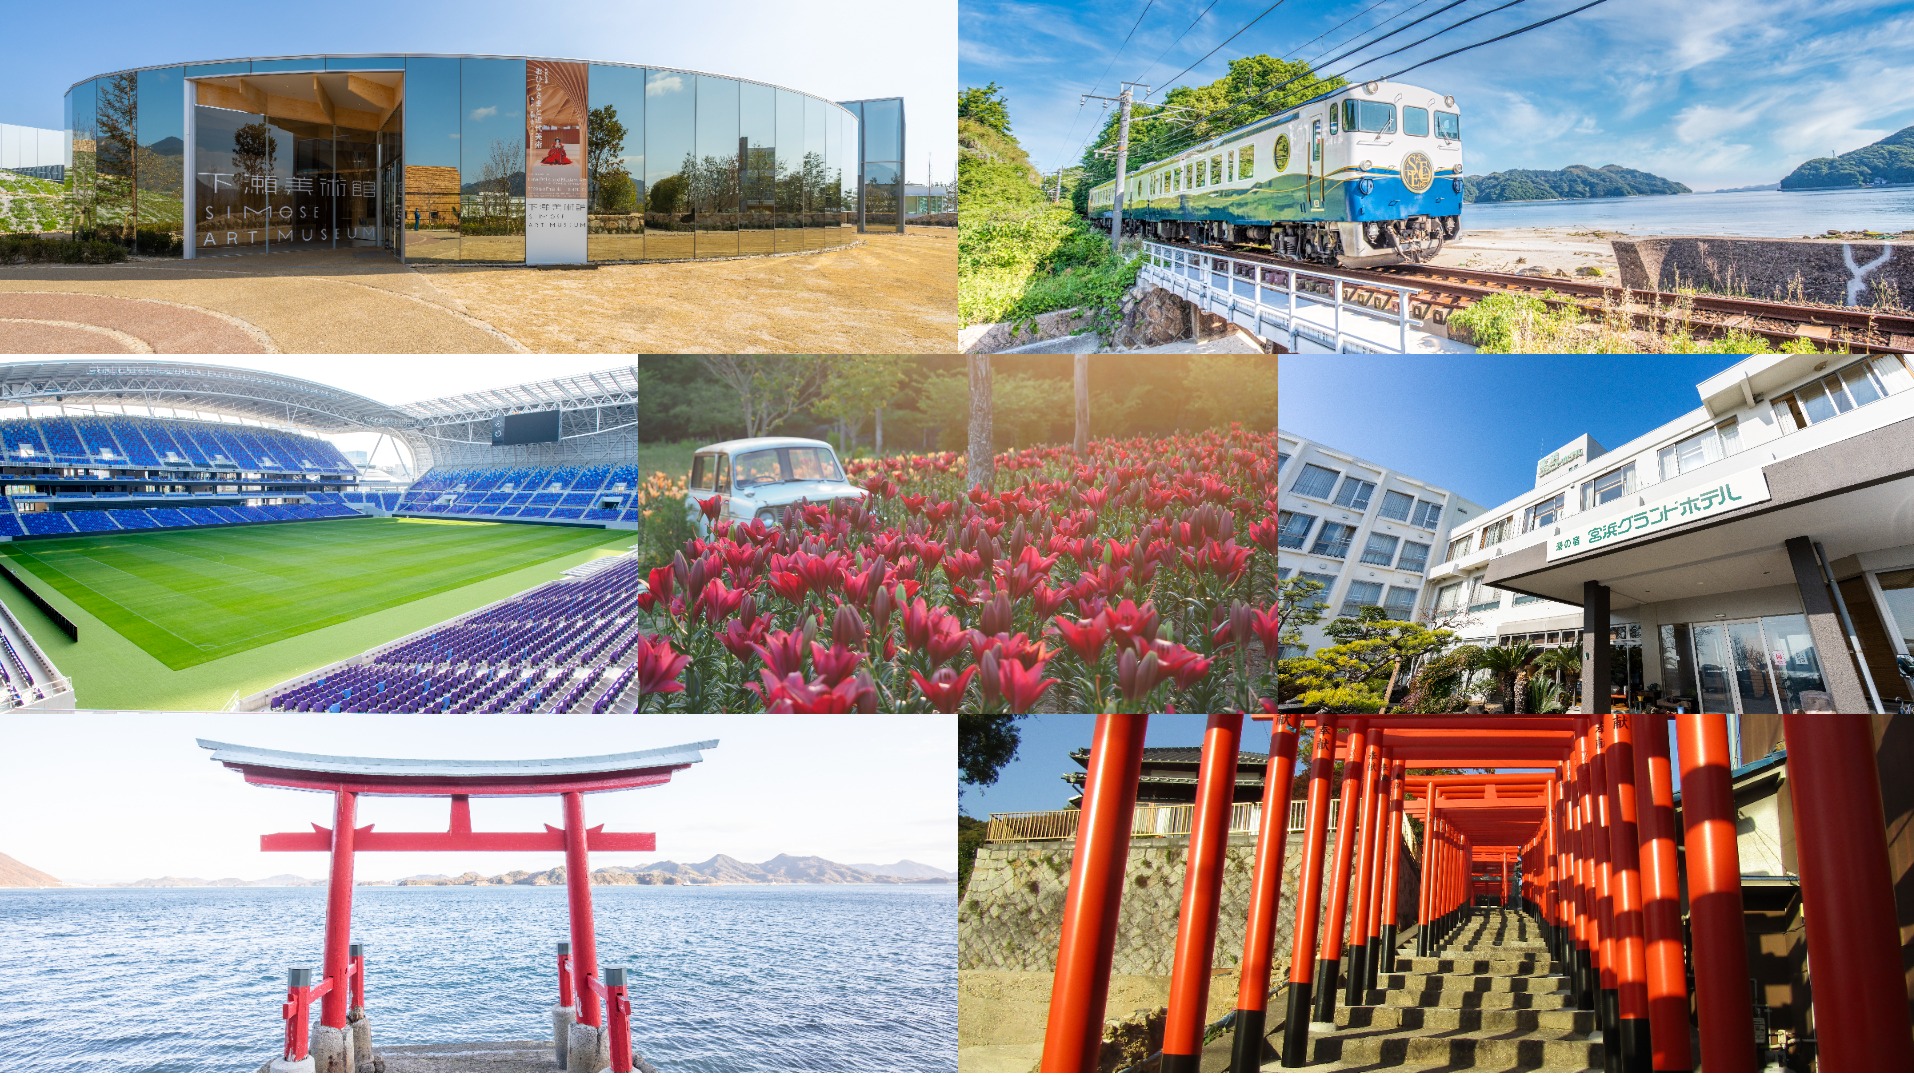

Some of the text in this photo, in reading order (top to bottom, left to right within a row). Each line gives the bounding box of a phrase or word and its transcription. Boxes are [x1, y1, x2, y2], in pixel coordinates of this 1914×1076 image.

[205, 205, 319, 220] SIMOSE
[203, 227, 375, 246] ART MUSEUM
[1587, 483, 1742, 544] 宮浜グランドホテル
